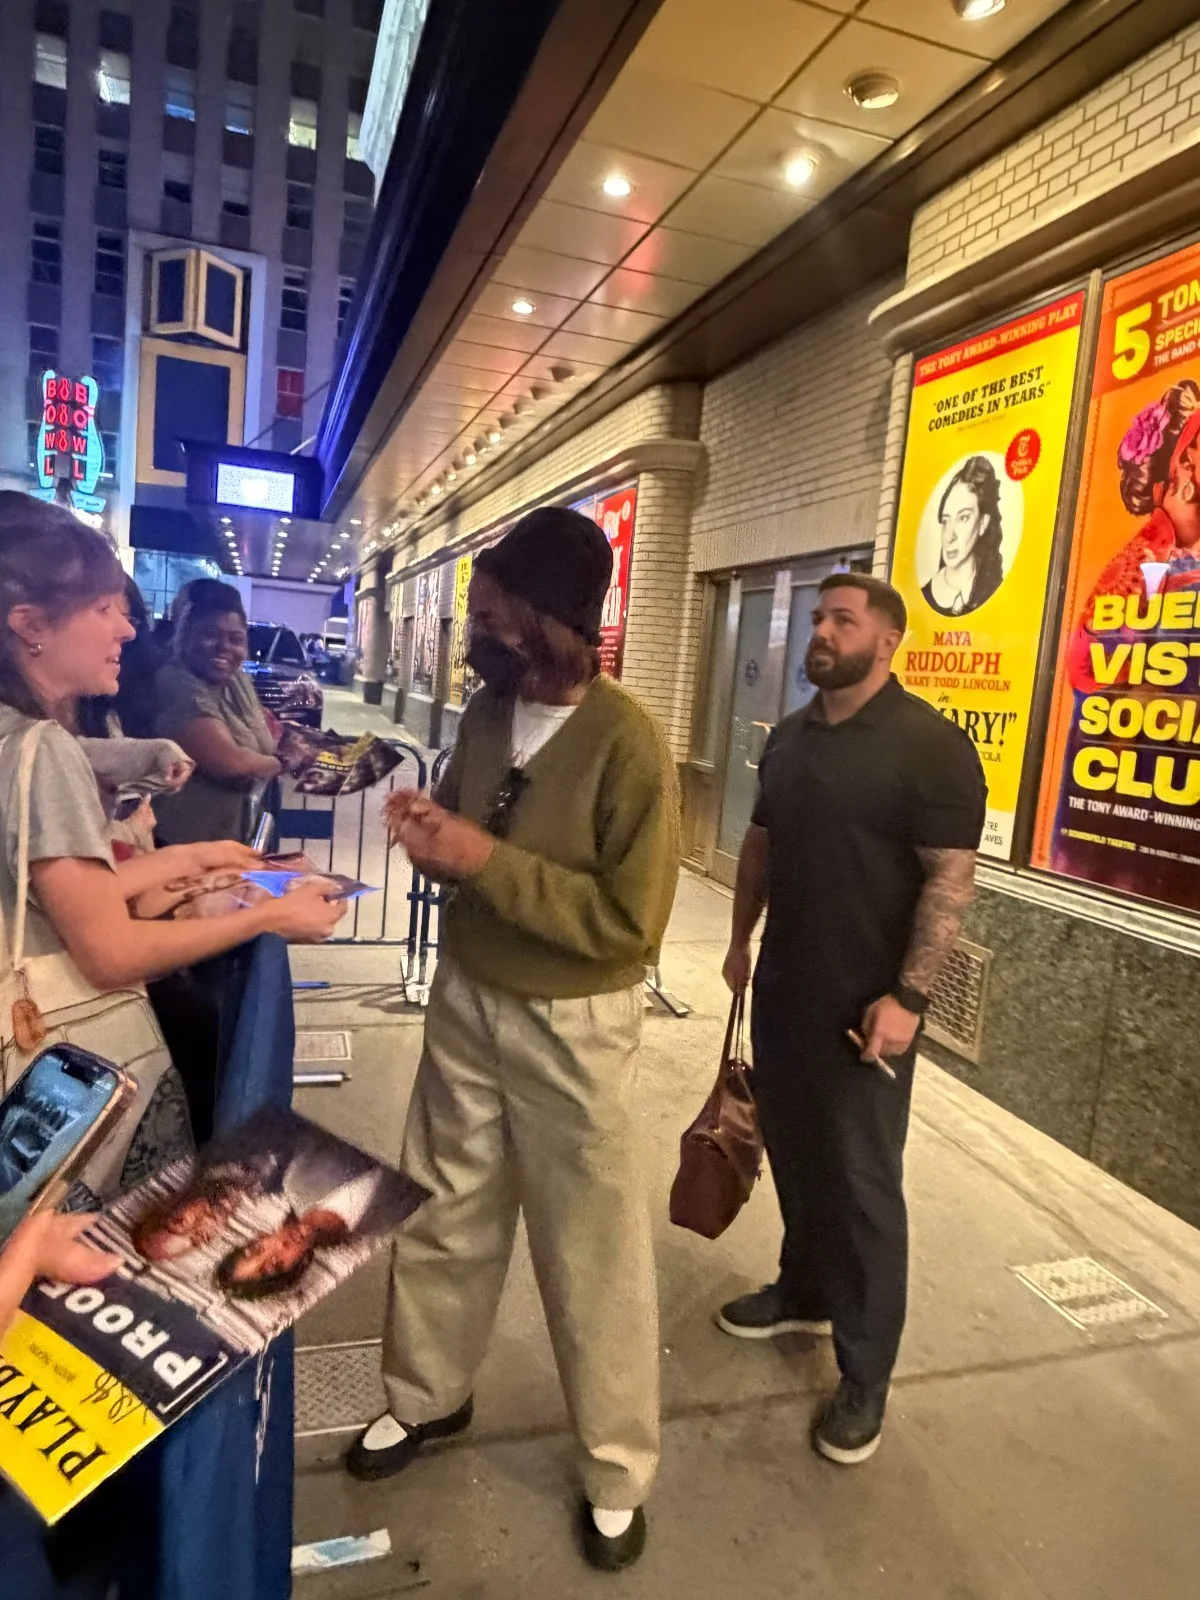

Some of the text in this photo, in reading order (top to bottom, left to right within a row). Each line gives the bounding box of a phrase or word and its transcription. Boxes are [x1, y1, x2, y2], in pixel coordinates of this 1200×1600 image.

[919, 303, 1079, 376] THE TONY AWARD-WINNING PLAY
[1112, 302, 1152, 380] 5
[1155, 317, 1200, 351] SPECI
[1153, 350, 1170, 367] THE
[1171, 340, 1196, 360] BAND
[962, 388, 978, 405] OF
[981, 378, 1006, 399] THE
[1009, 365, 1044, 389] BEST
[928, 404, 984, 432] COMEDIES
[987, 398, 1001, 414] IN
[1092, 590, 1200, 631] BUE
[933, 631, 972, 646] MAYA
[905, 651, 1002, 675] RUDOLPH
[905, 675, 1011, 692] MARY TODD LINCOLN
[1079, 696, 1200, 744] SOCI
[1068, 795, 1085, 810] THE
[1088, 799, 1112, 815] TONY
